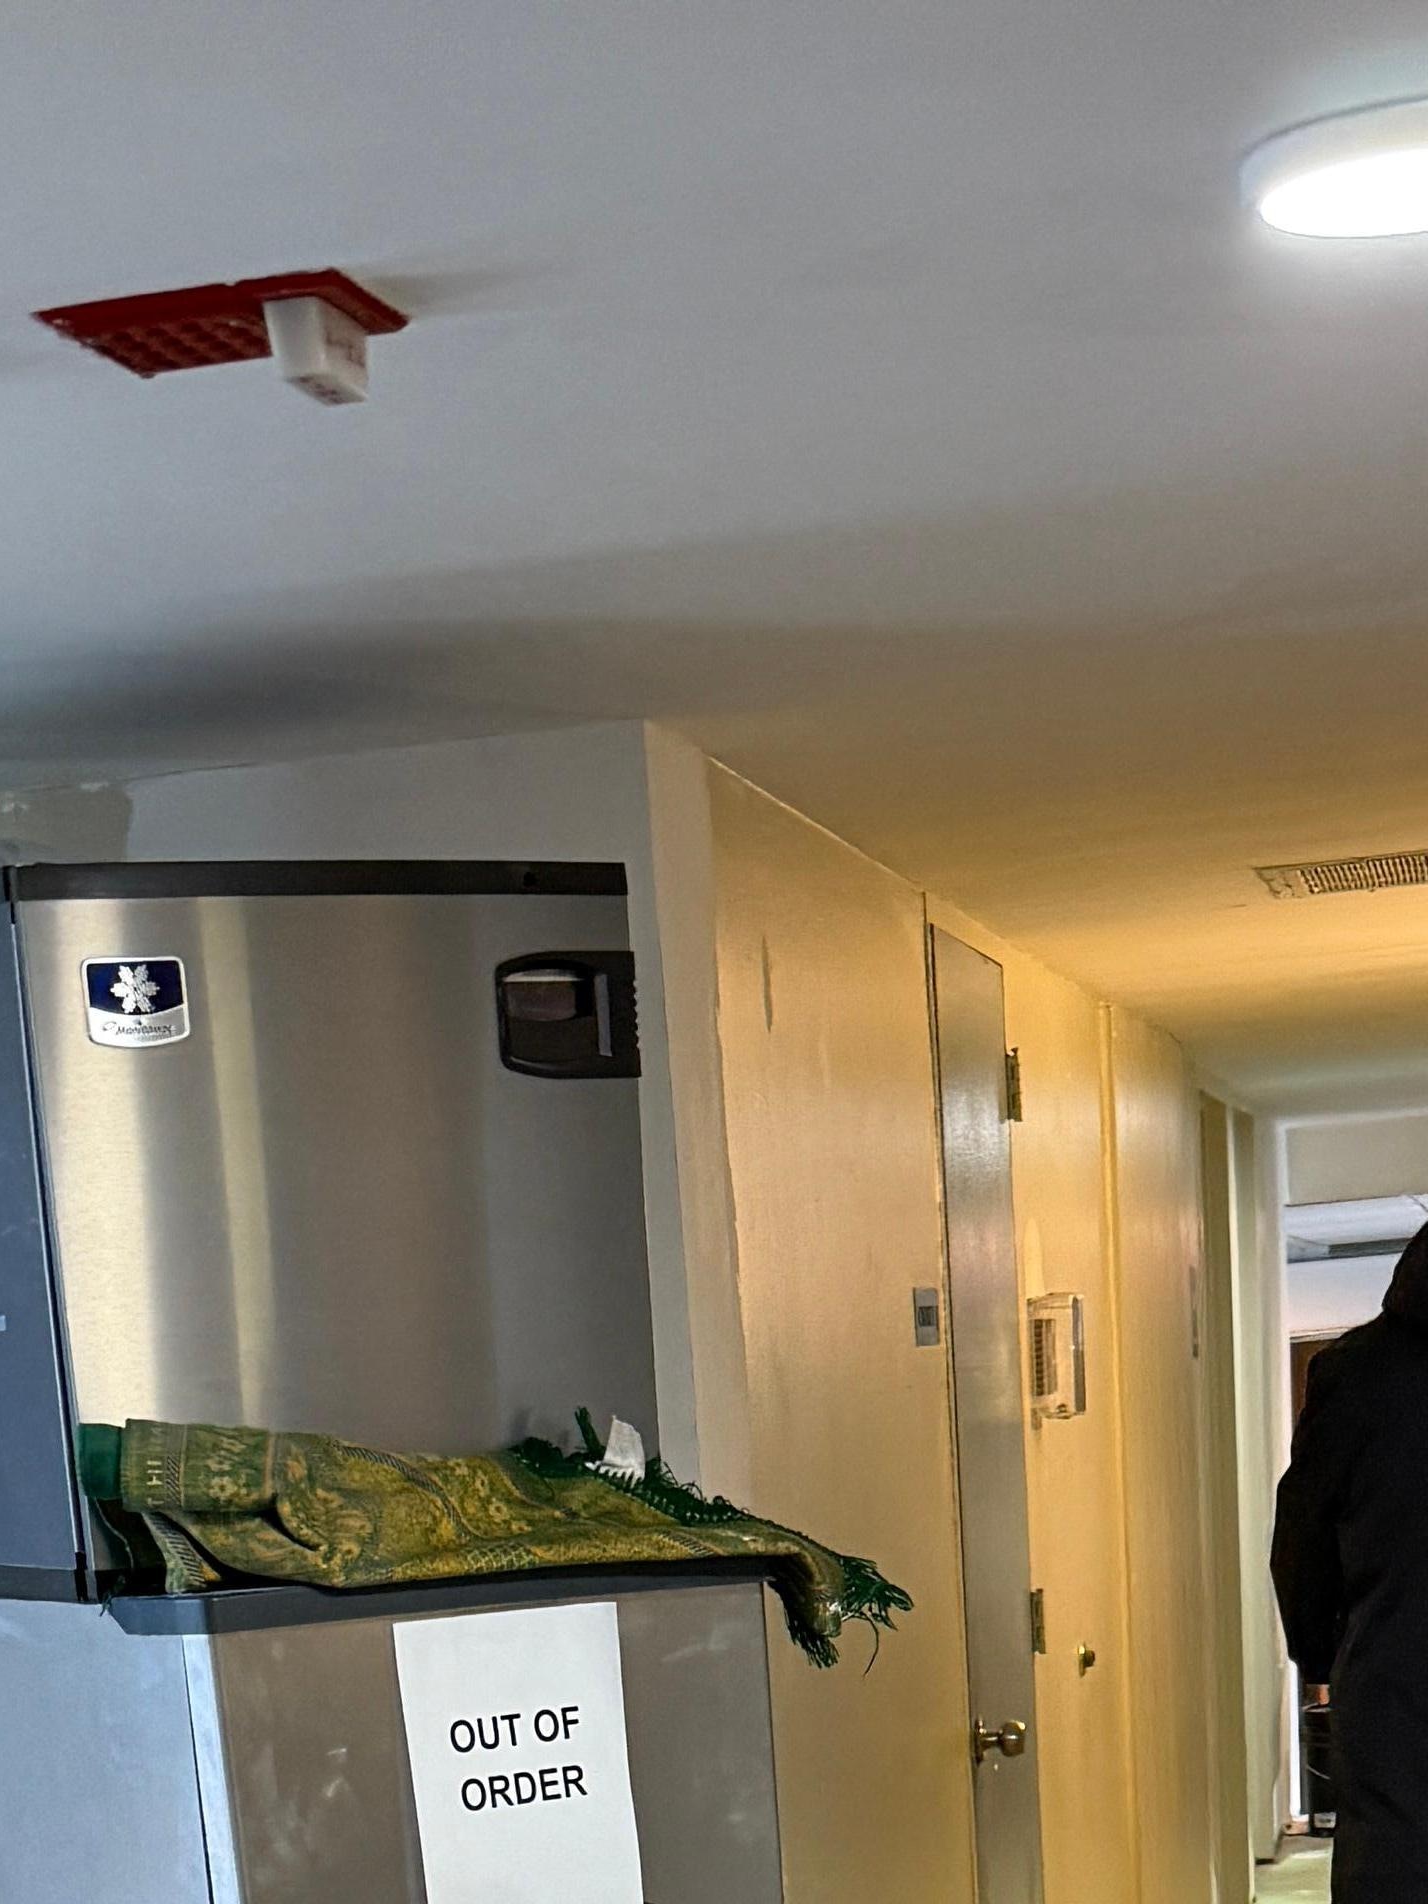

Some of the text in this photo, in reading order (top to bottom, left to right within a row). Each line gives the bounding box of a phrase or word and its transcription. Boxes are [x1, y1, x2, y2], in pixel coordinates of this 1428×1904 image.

[450, 1706, 580, 1753] OUT OF
[461, 1765, 588, 1811] ORDER
